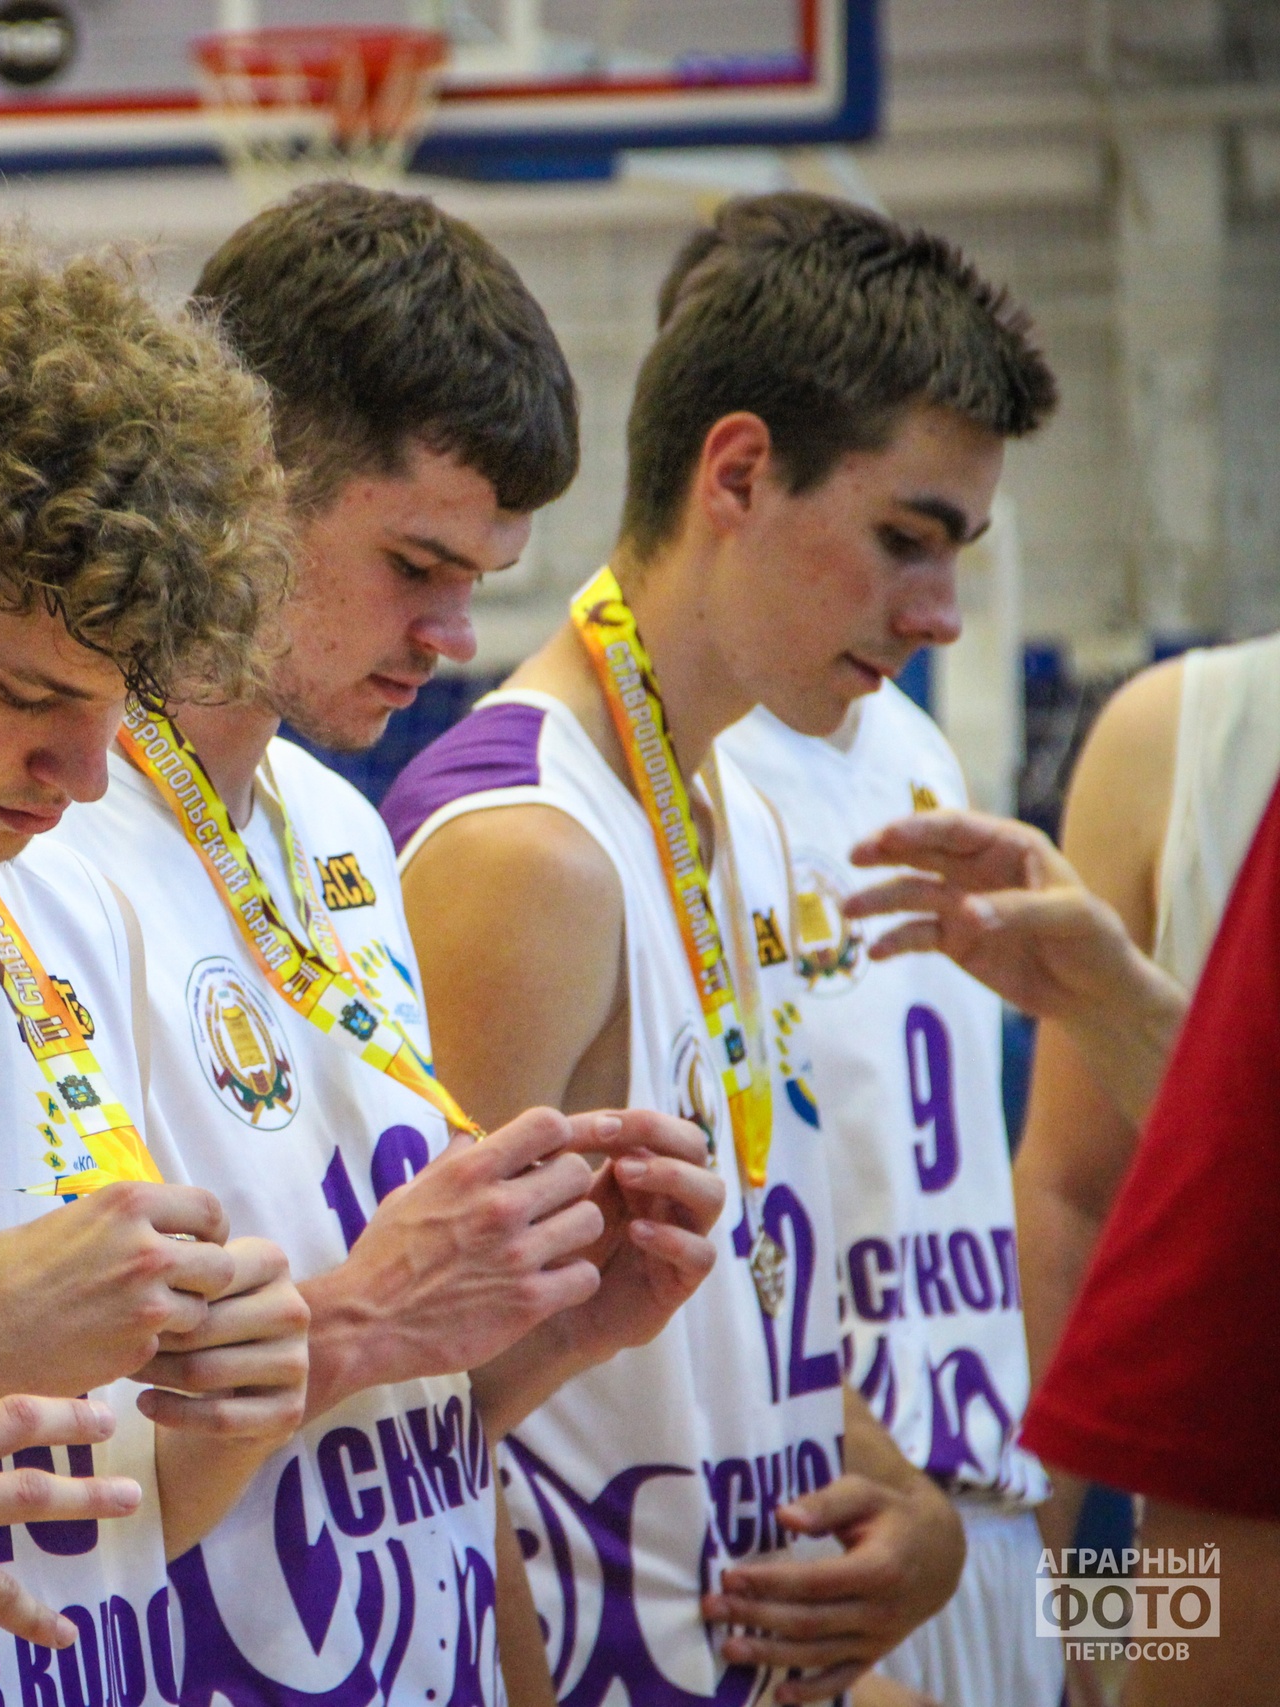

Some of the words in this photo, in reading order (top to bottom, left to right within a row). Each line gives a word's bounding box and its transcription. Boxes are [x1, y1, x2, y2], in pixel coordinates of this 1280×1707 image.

[122, 703, 251, 899] ВРОПОЛЬСКИЙ
[241, 896, 292, 973] КРАЙ
[905, 1003, 963, 1194] 9
[730, 1182, 843, 1405] 12
